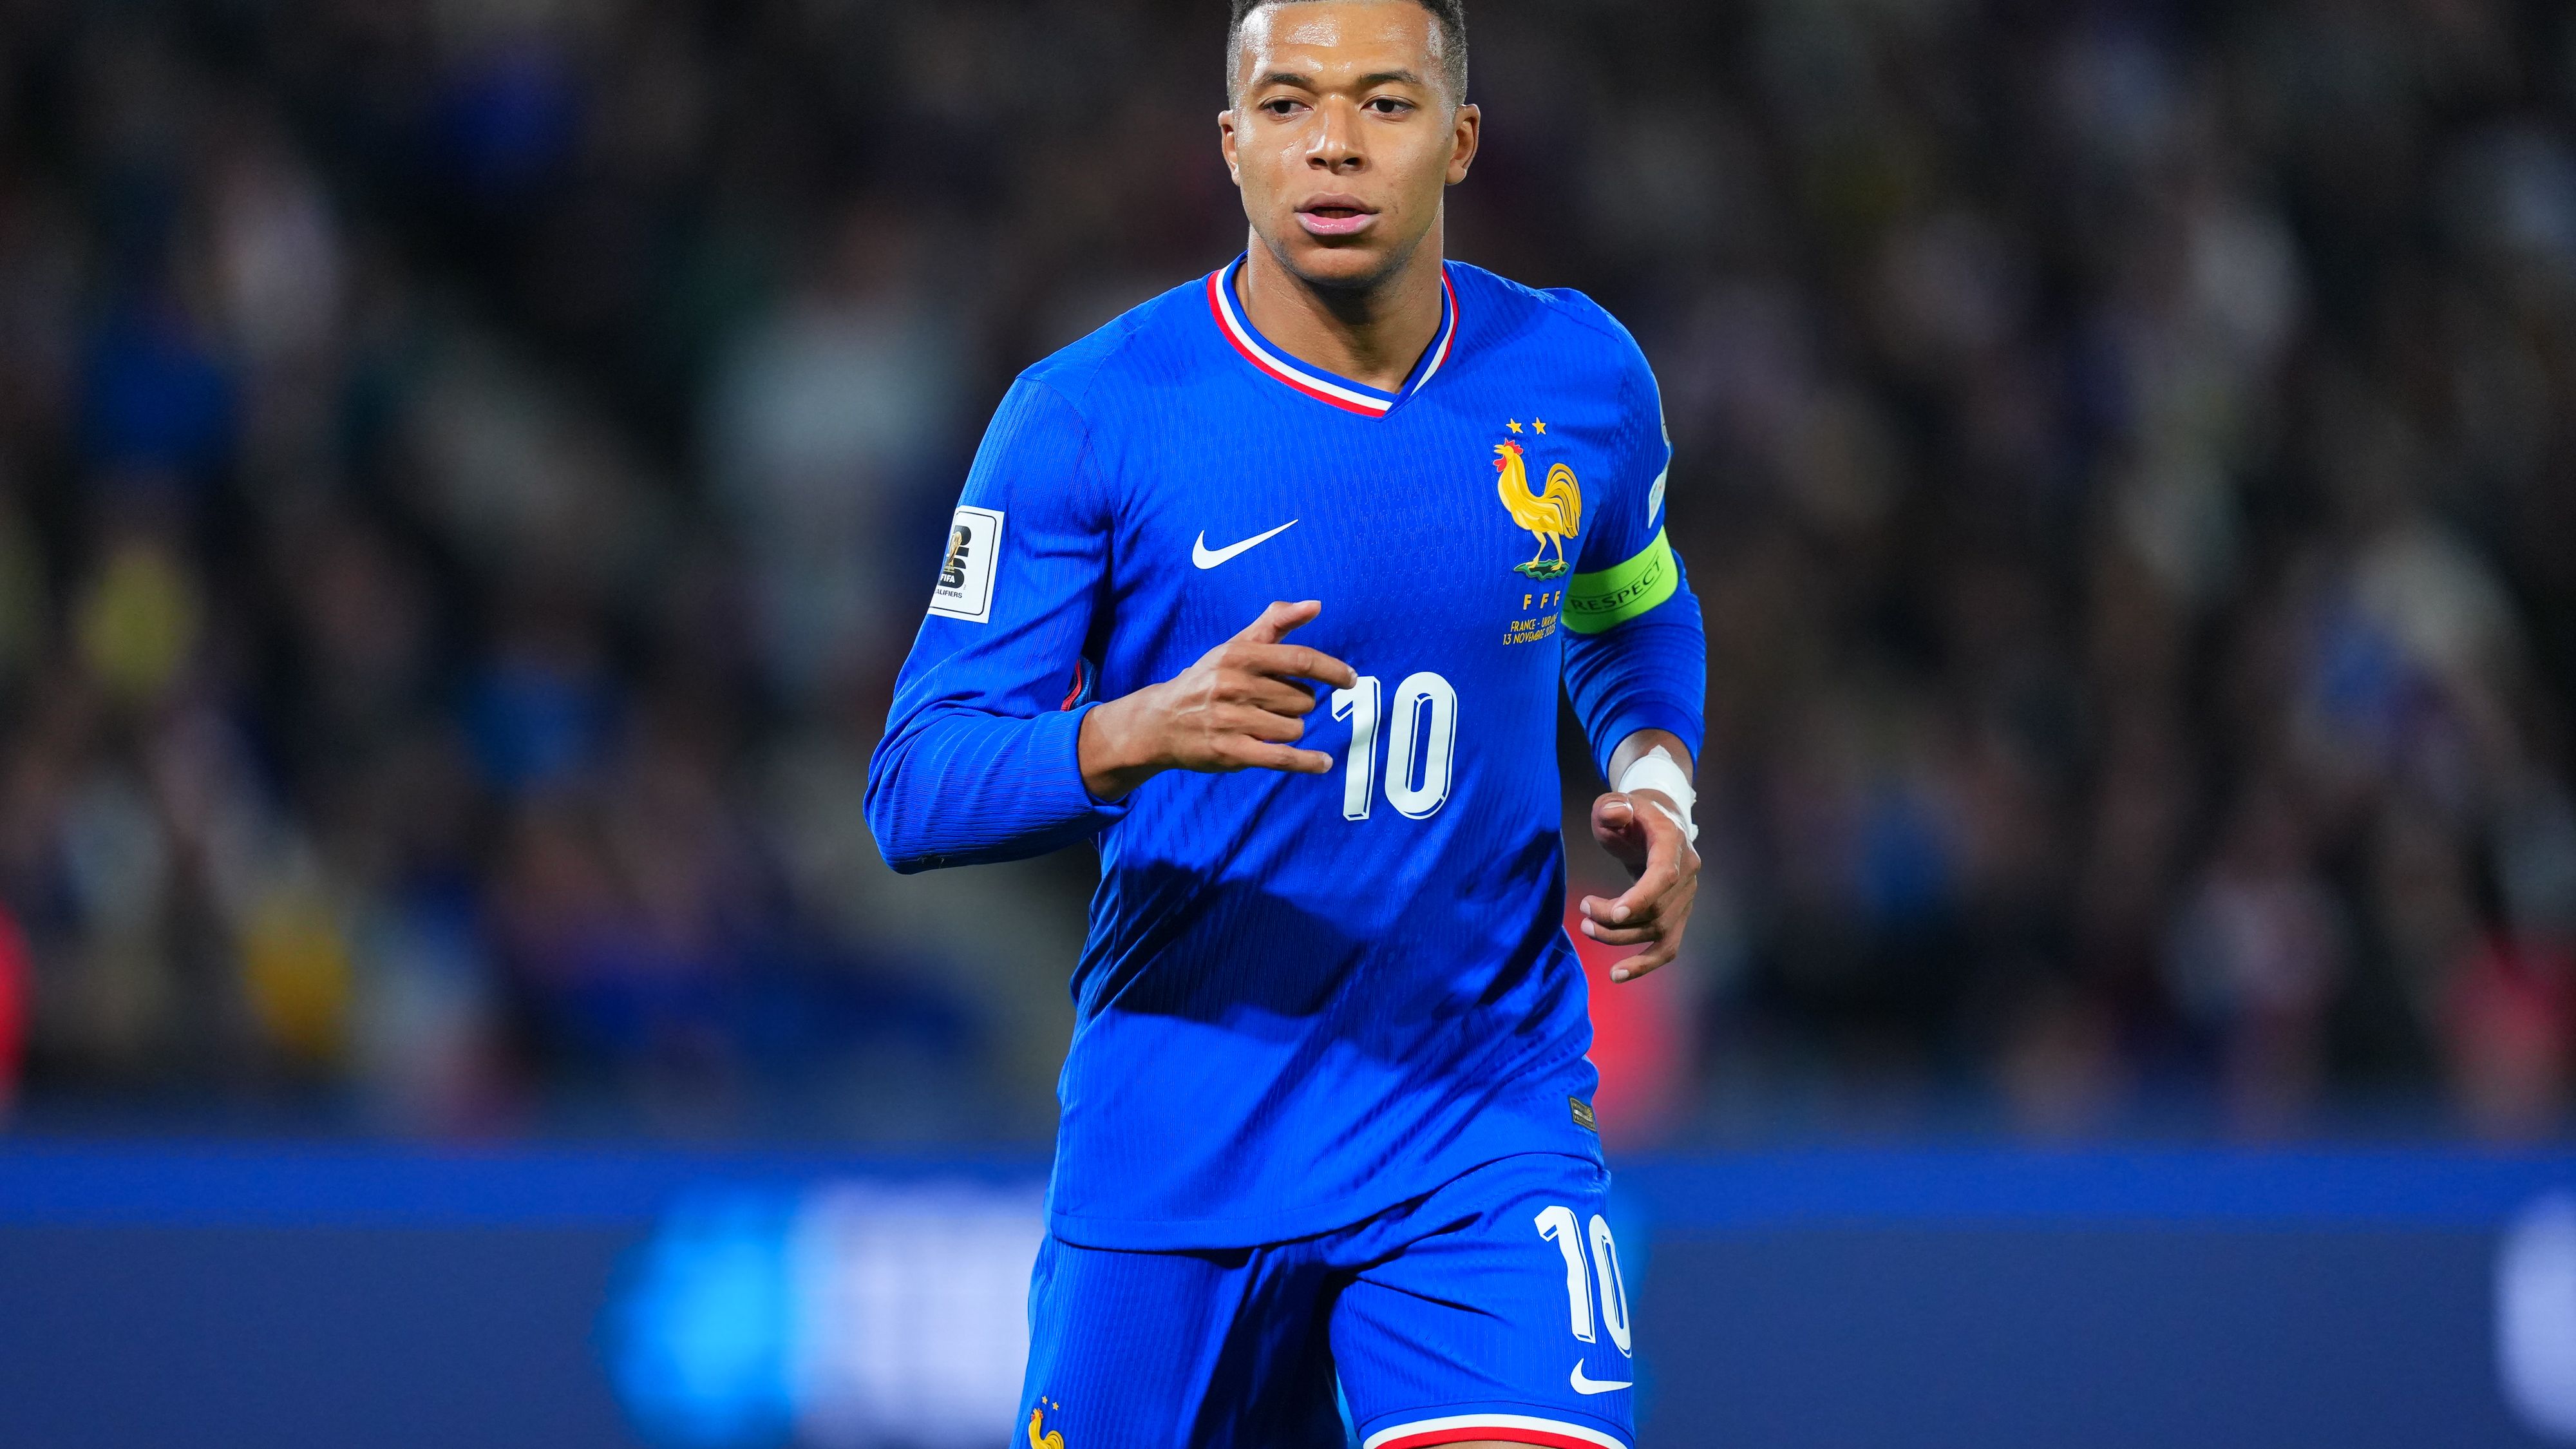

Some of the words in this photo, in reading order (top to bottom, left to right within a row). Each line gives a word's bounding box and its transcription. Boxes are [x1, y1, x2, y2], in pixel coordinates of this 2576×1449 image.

[940, 573, 956, 583] FIFA
[1571, 555, 1660, 611] RESPECT
[936, 589, 962, 598] ALIFIERS
[1511, 618, 1537, 632] FRANCE
[1503, 633, 1511, 645] 13
[1513, 629, 1546, 644] NOVEMBRE
[1332, 672, 1457, 821] 10
[1535, 1206, 1631, 1358] 10
